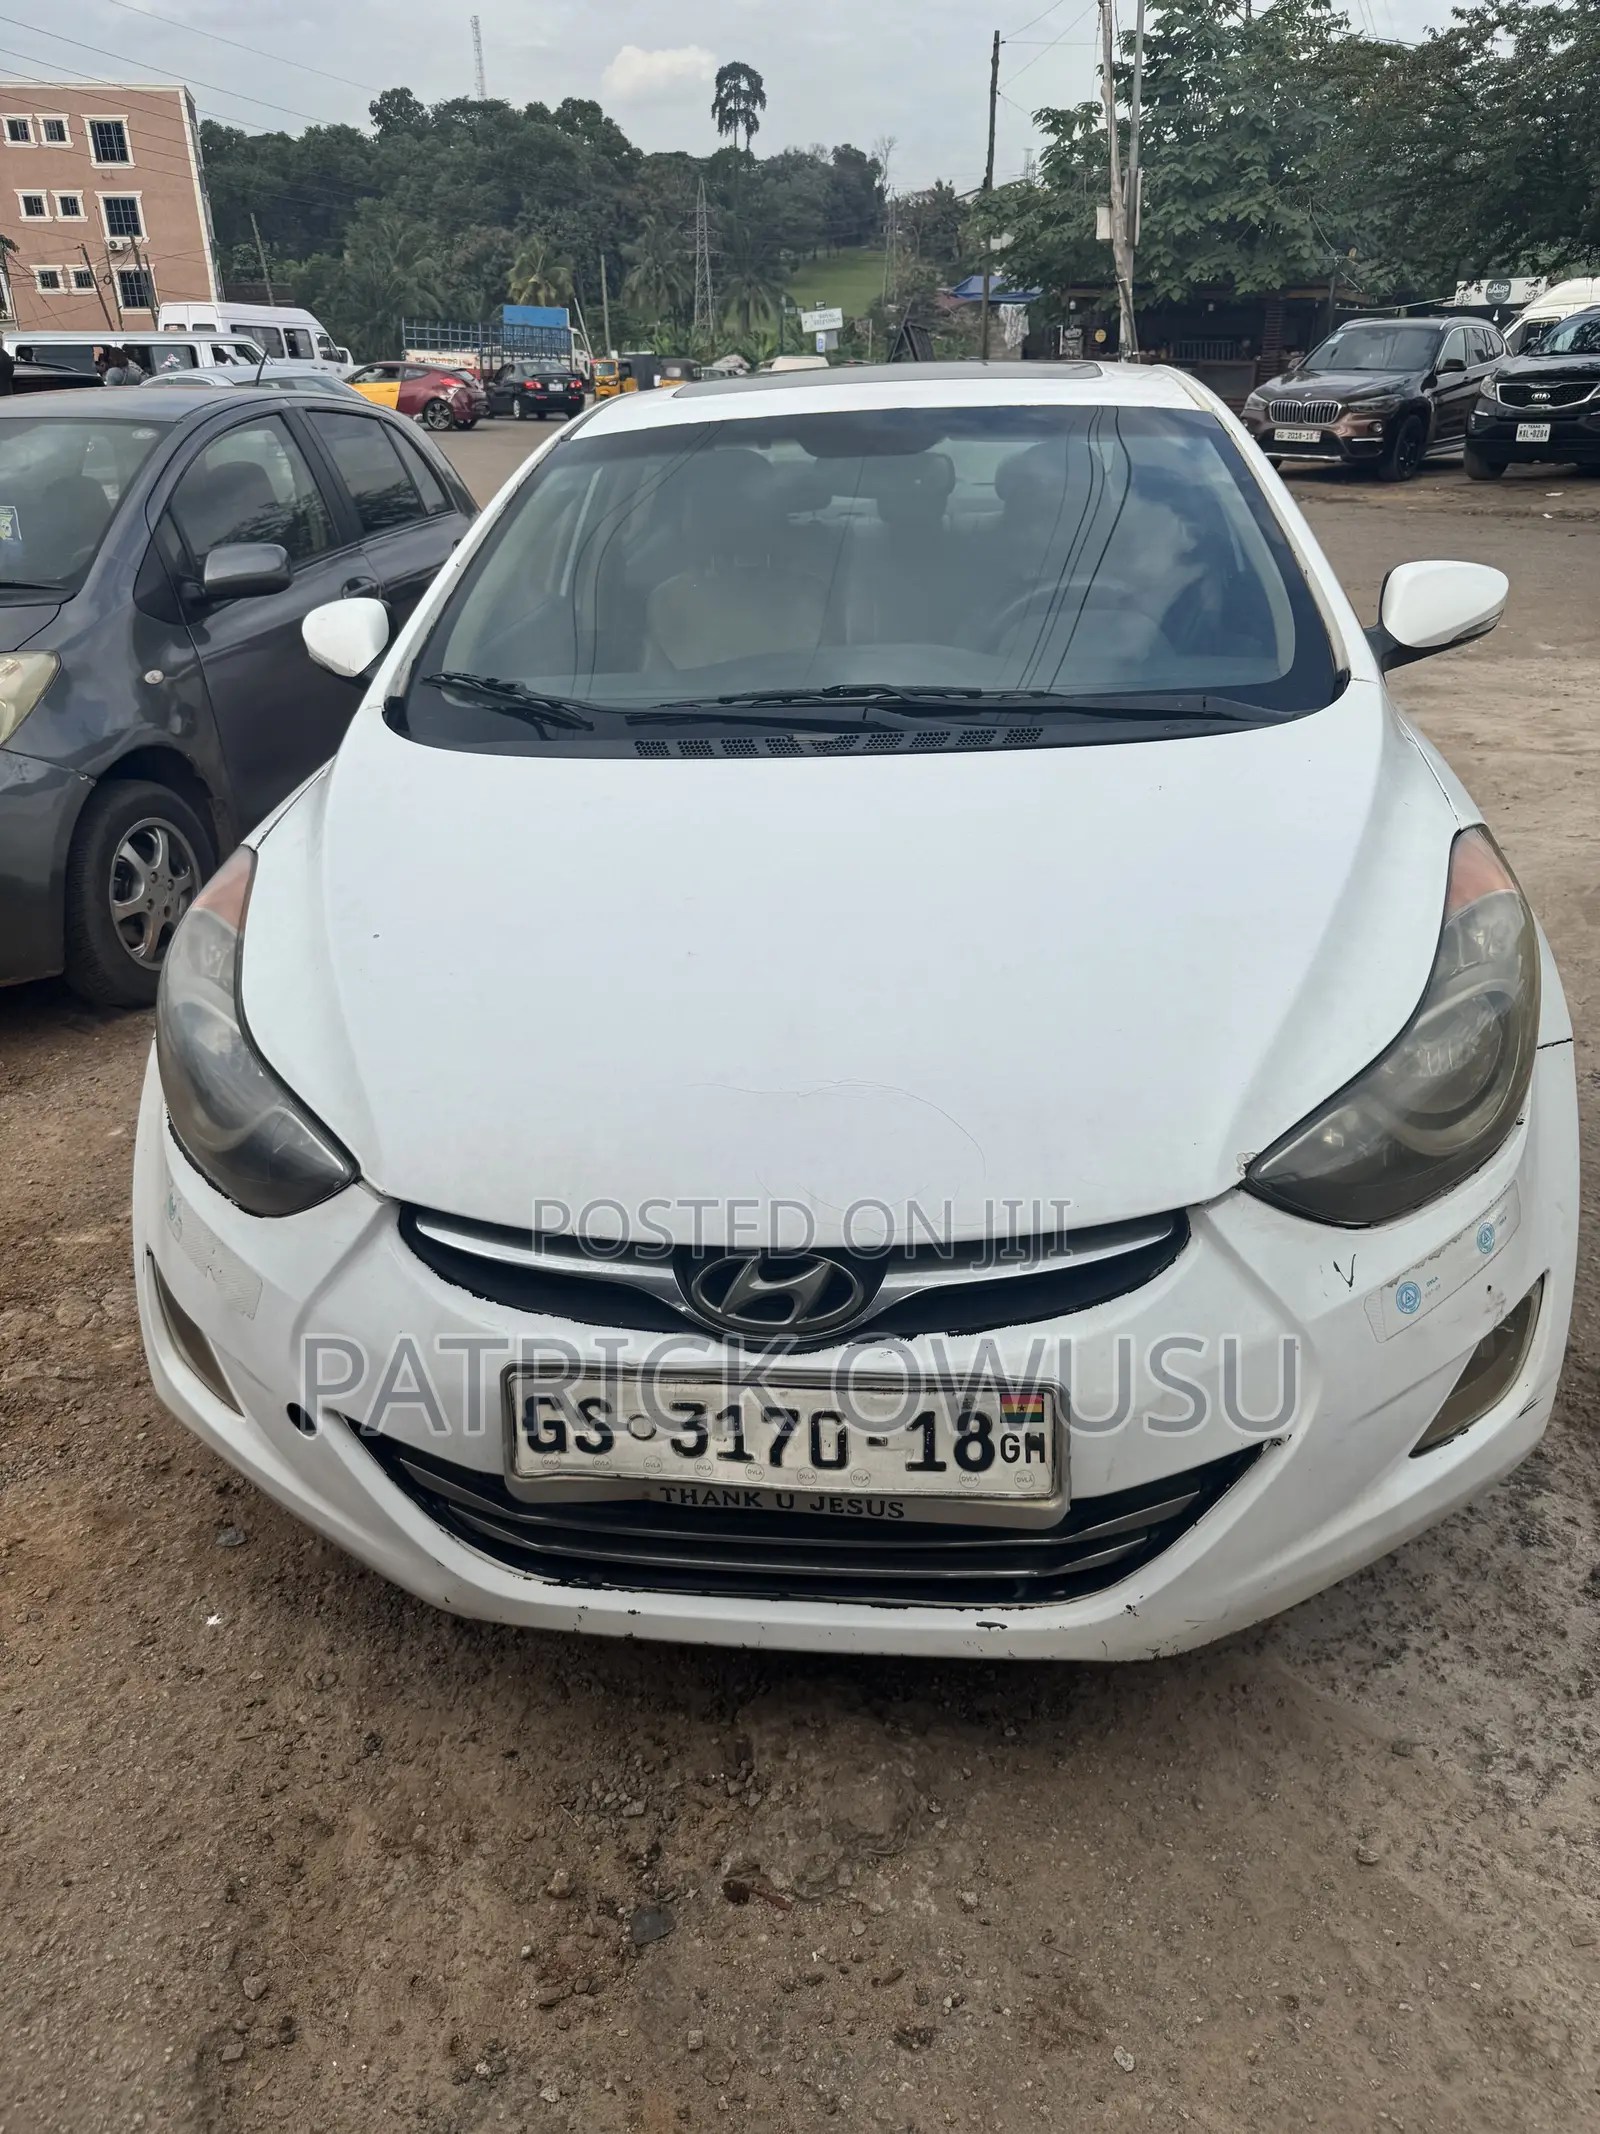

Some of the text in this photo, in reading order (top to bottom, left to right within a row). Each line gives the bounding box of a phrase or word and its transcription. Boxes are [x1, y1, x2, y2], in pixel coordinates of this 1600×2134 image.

[524, 1397, 615, 1455] GS
[1000, 1432, 1046, 1465] GH
[659, 1487, 905, 1519] THANK U JESUS
